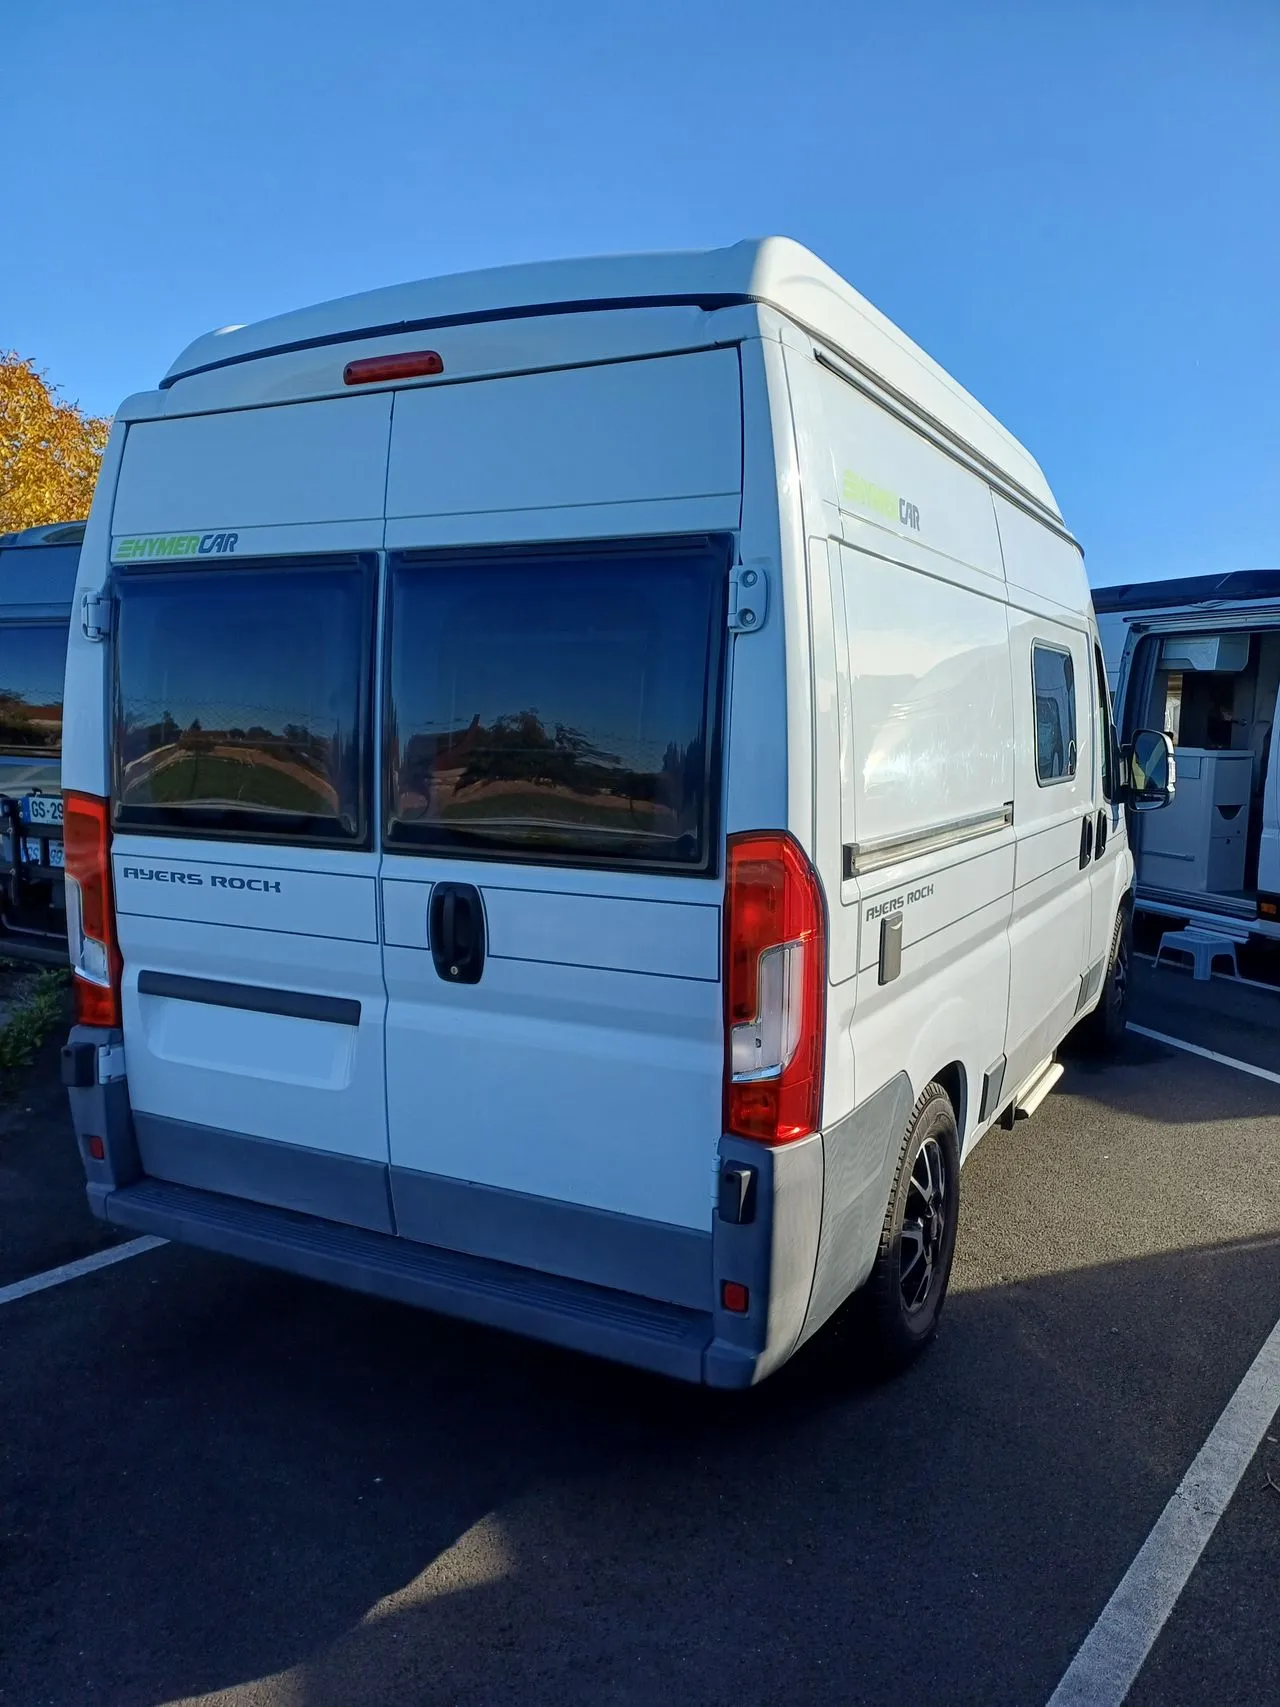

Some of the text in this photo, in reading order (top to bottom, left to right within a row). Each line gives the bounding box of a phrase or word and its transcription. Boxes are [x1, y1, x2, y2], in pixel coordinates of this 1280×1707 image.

[123, 867, 281, 893] AYERS ROCK
[866, 883, 934, 922] AYERS ROCK
